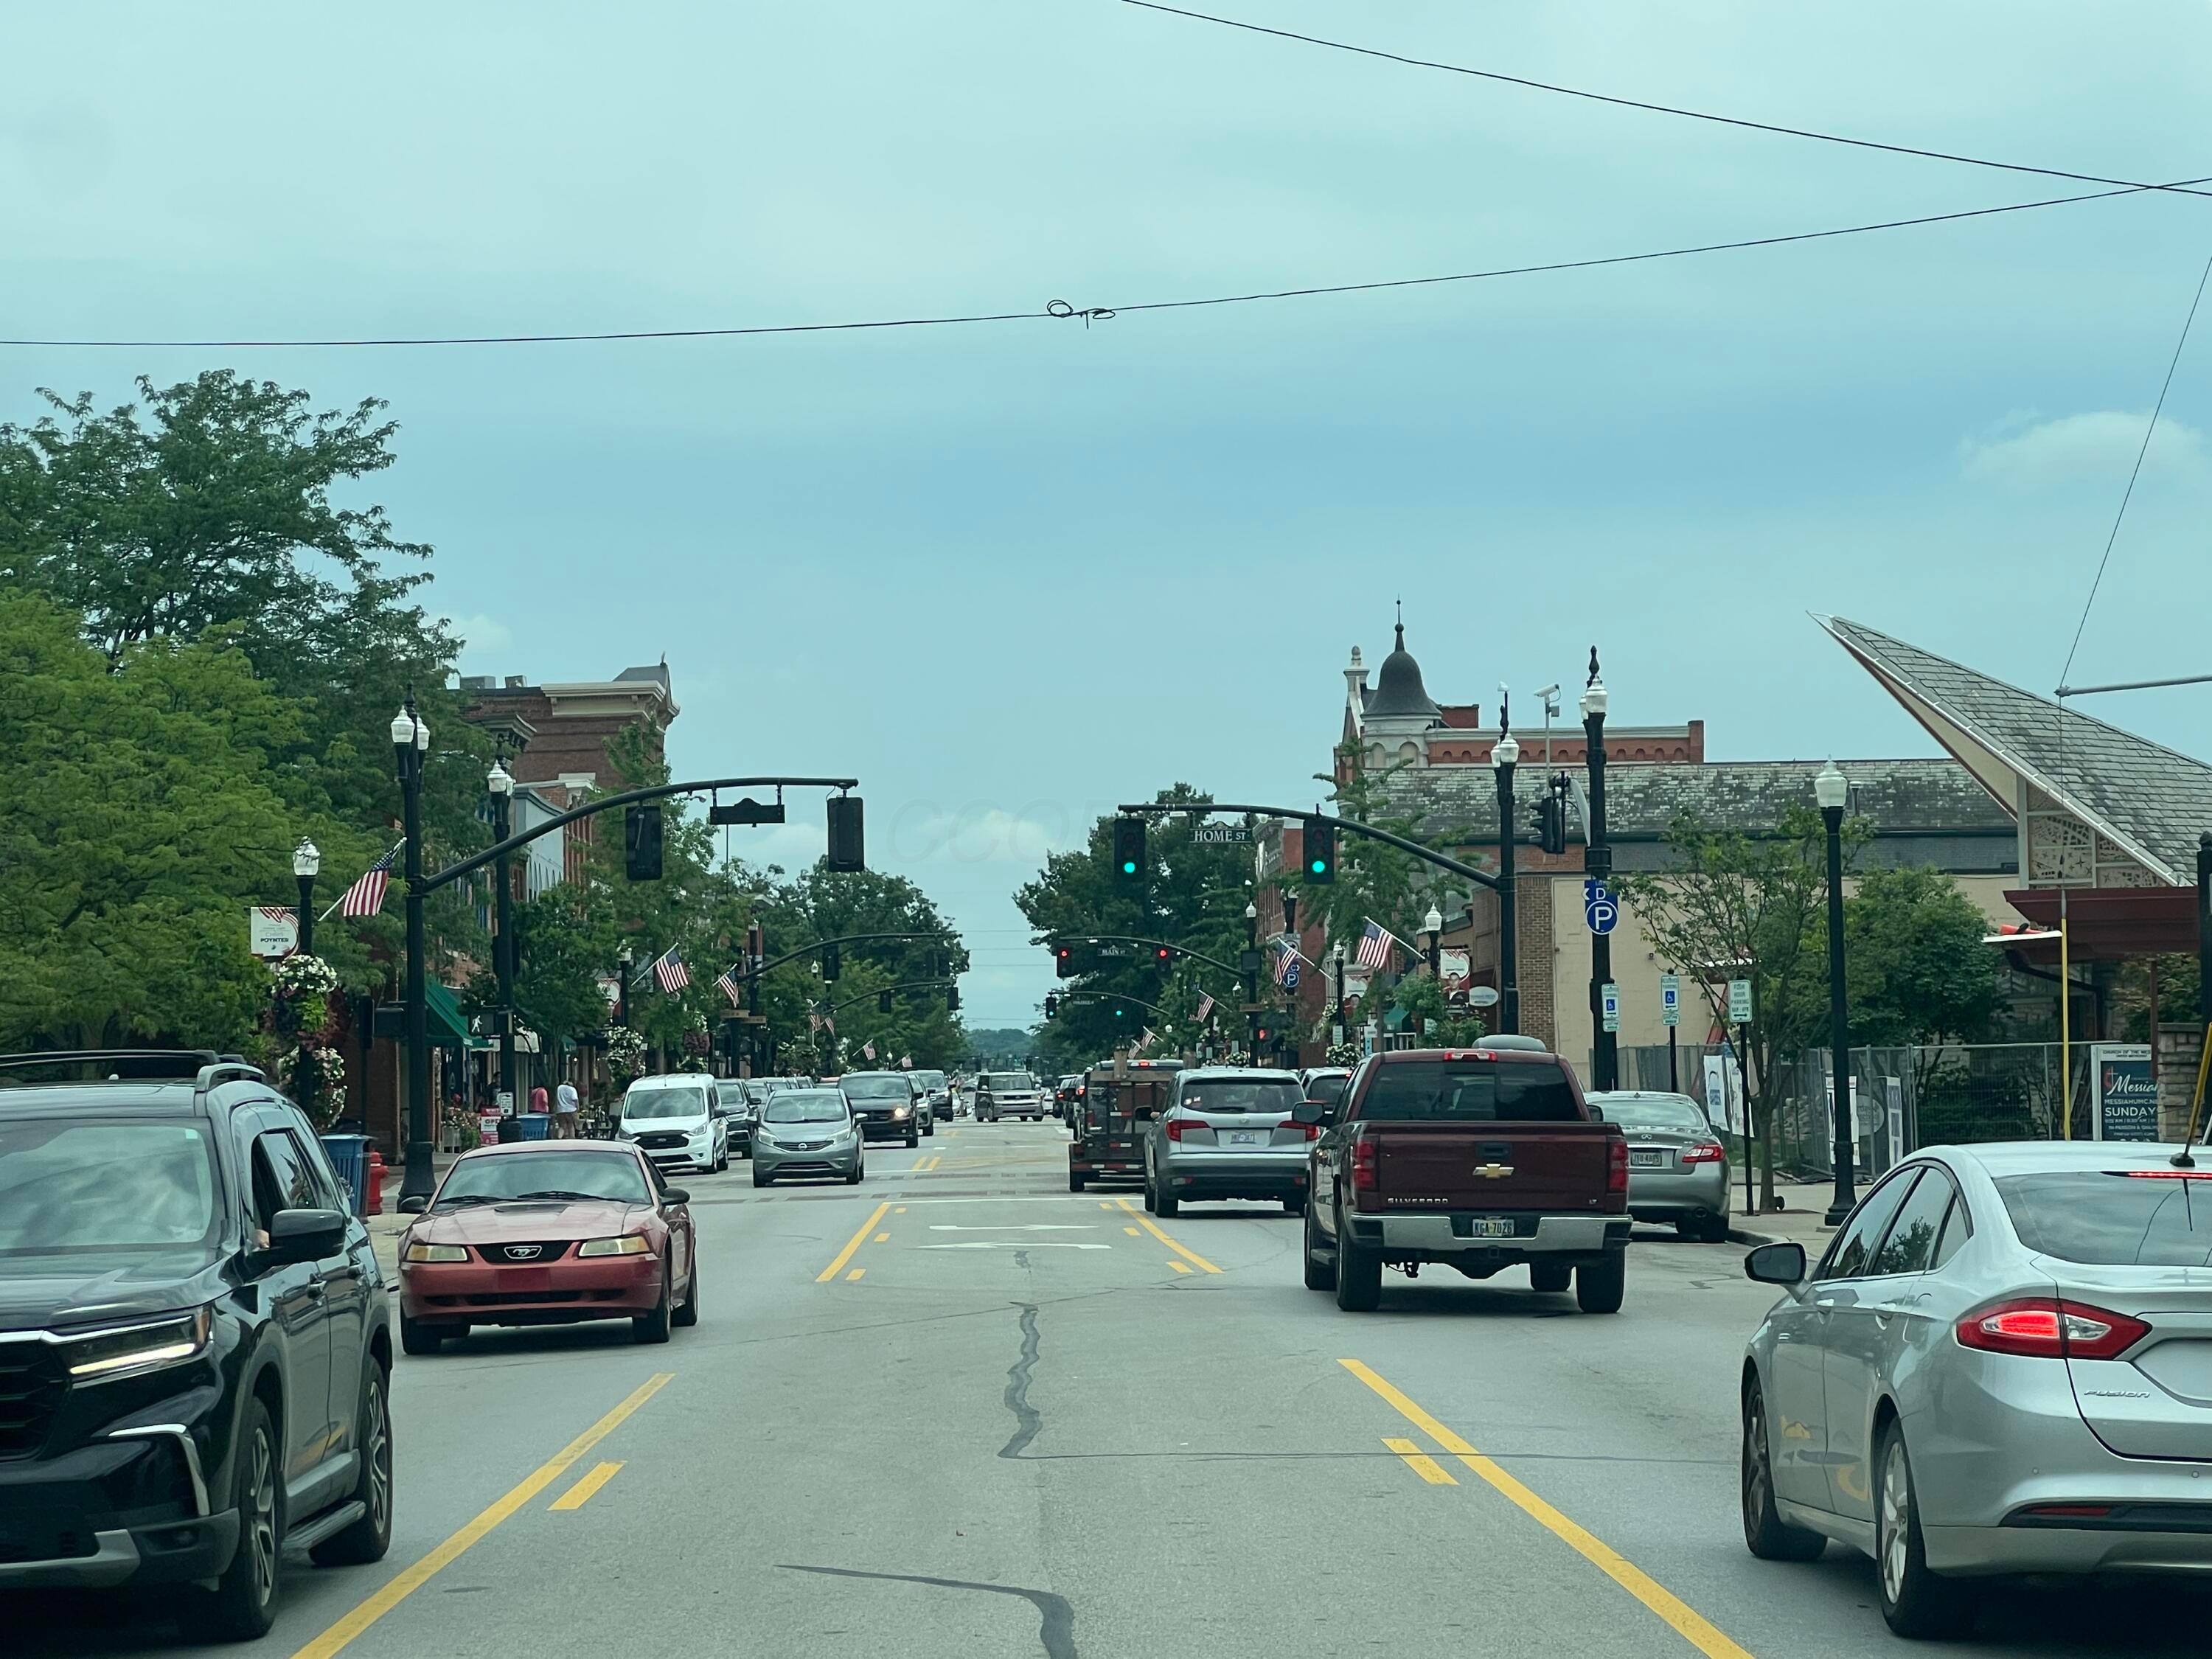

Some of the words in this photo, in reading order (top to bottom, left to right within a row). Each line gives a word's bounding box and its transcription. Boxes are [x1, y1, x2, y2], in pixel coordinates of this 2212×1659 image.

[1194, 830, 1233, 842] HOME
[1235, 832, 1246, 841] ST
[1596, 888, 1606, 900] D
[1595, 906, 1613, 930] P
[1287, 973, 1296, 985] P
[1474, 1220, 1489, 1234] KGA
[1492, 1220, 1512, 1235] 7026
